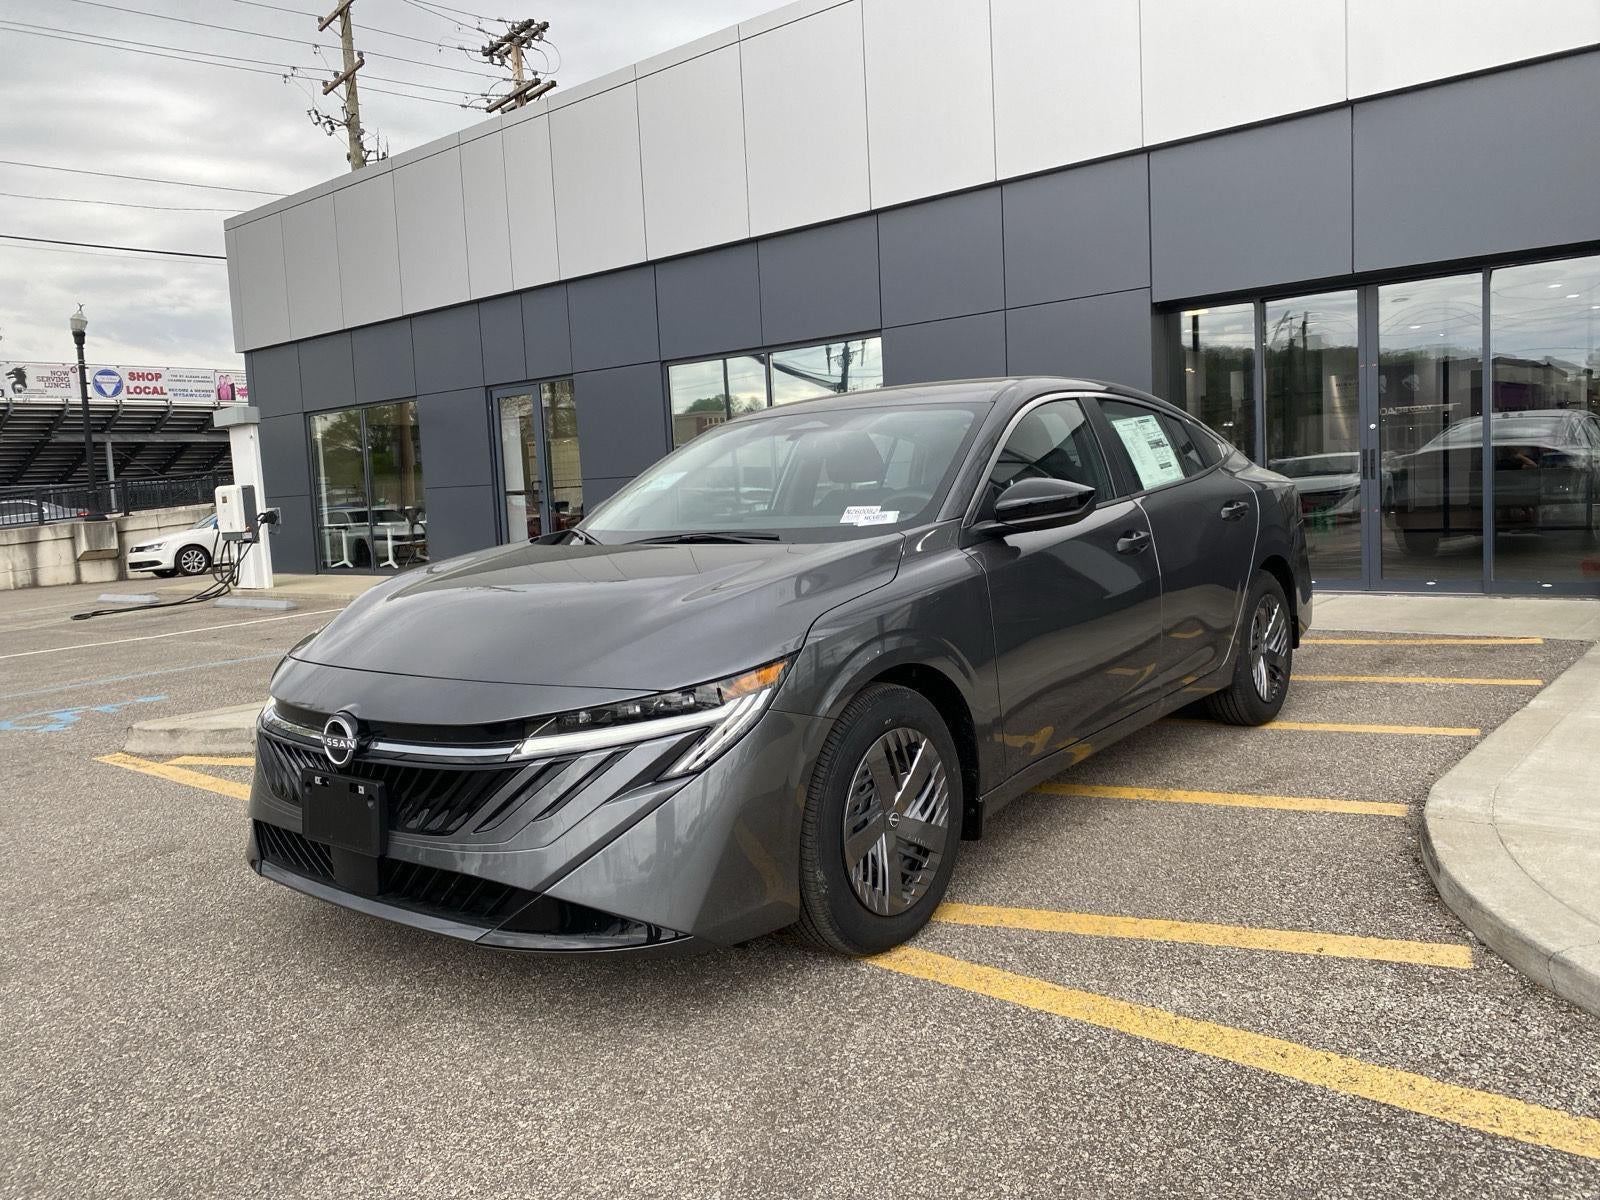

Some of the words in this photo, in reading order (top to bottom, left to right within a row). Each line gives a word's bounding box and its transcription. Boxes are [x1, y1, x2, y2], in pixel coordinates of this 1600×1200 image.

[128, 371, 162, 381] SHOP
[126, 386, 168, 395] LOCAL
[320, 735, 357, 749] NISSAN
